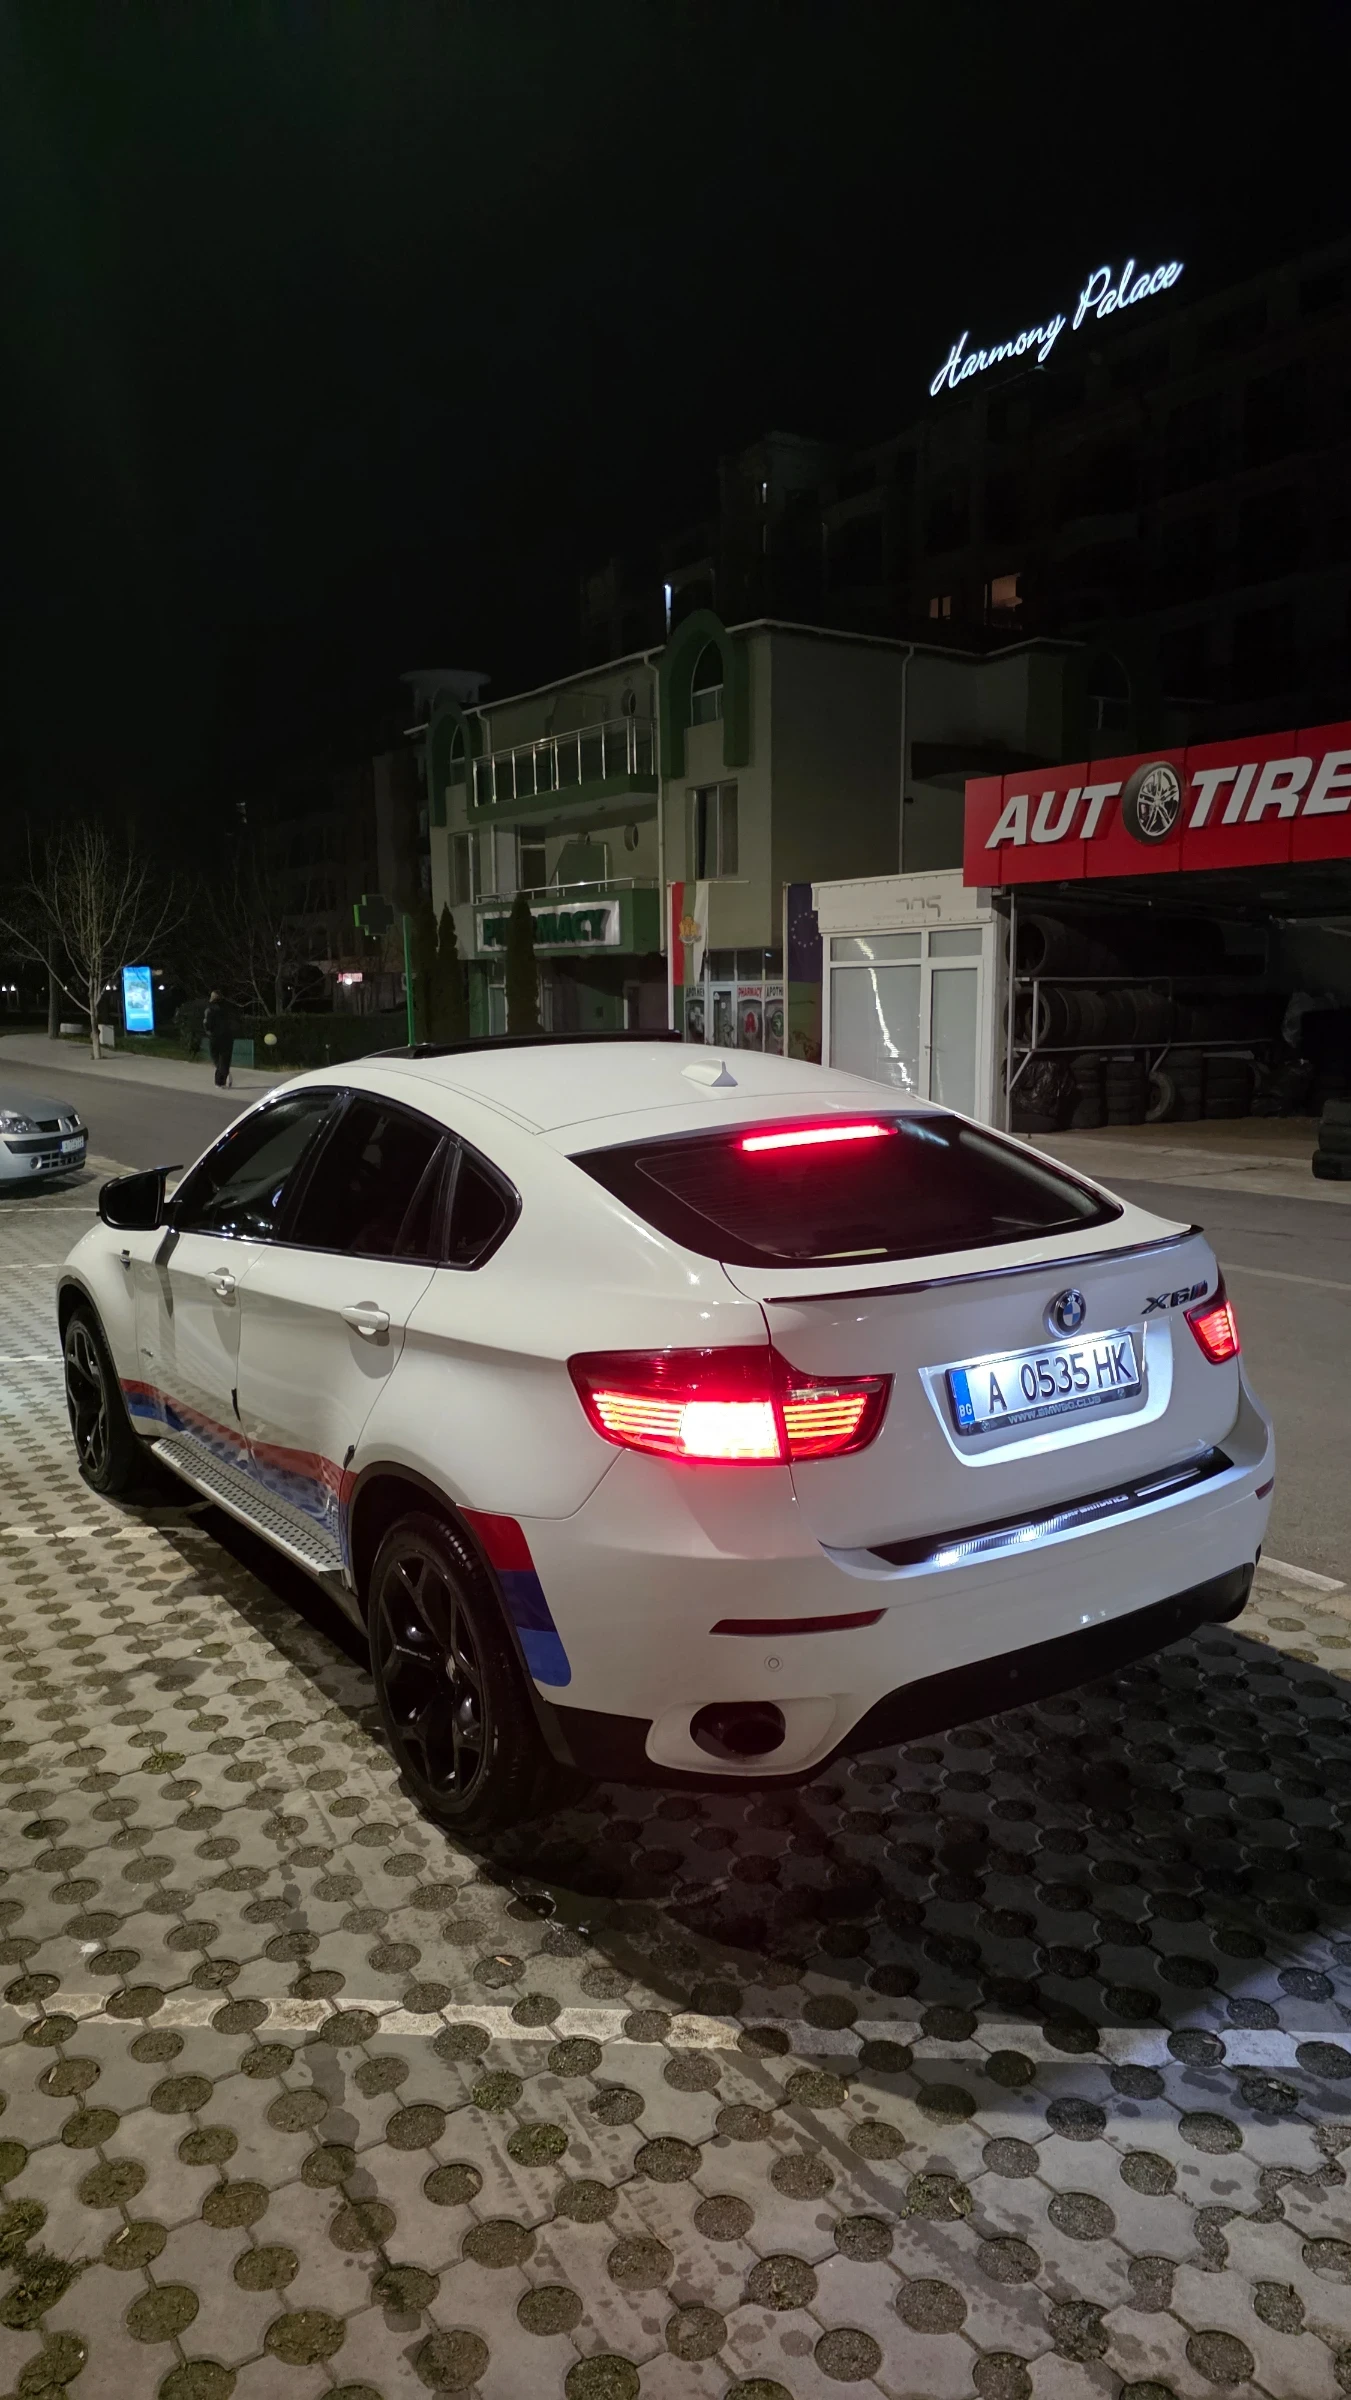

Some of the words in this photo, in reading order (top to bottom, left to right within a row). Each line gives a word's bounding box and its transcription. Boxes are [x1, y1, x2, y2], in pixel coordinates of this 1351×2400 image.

[929, 313, 1066, 397] Harmony
[1072, 258, 1184, 330] Palace
[1188, 749, 1351, 828] TIRE
[482, 908, 611, 946] PHMACY
[738, 986, 763, 998] PHARMACY
[989, 1371, 1007, 1413] A
[1020, 1352, 1090, 1401] 0535
[1093, 1341, 1132, 1388] HK
[959, 1404, 973, 1418] BG
